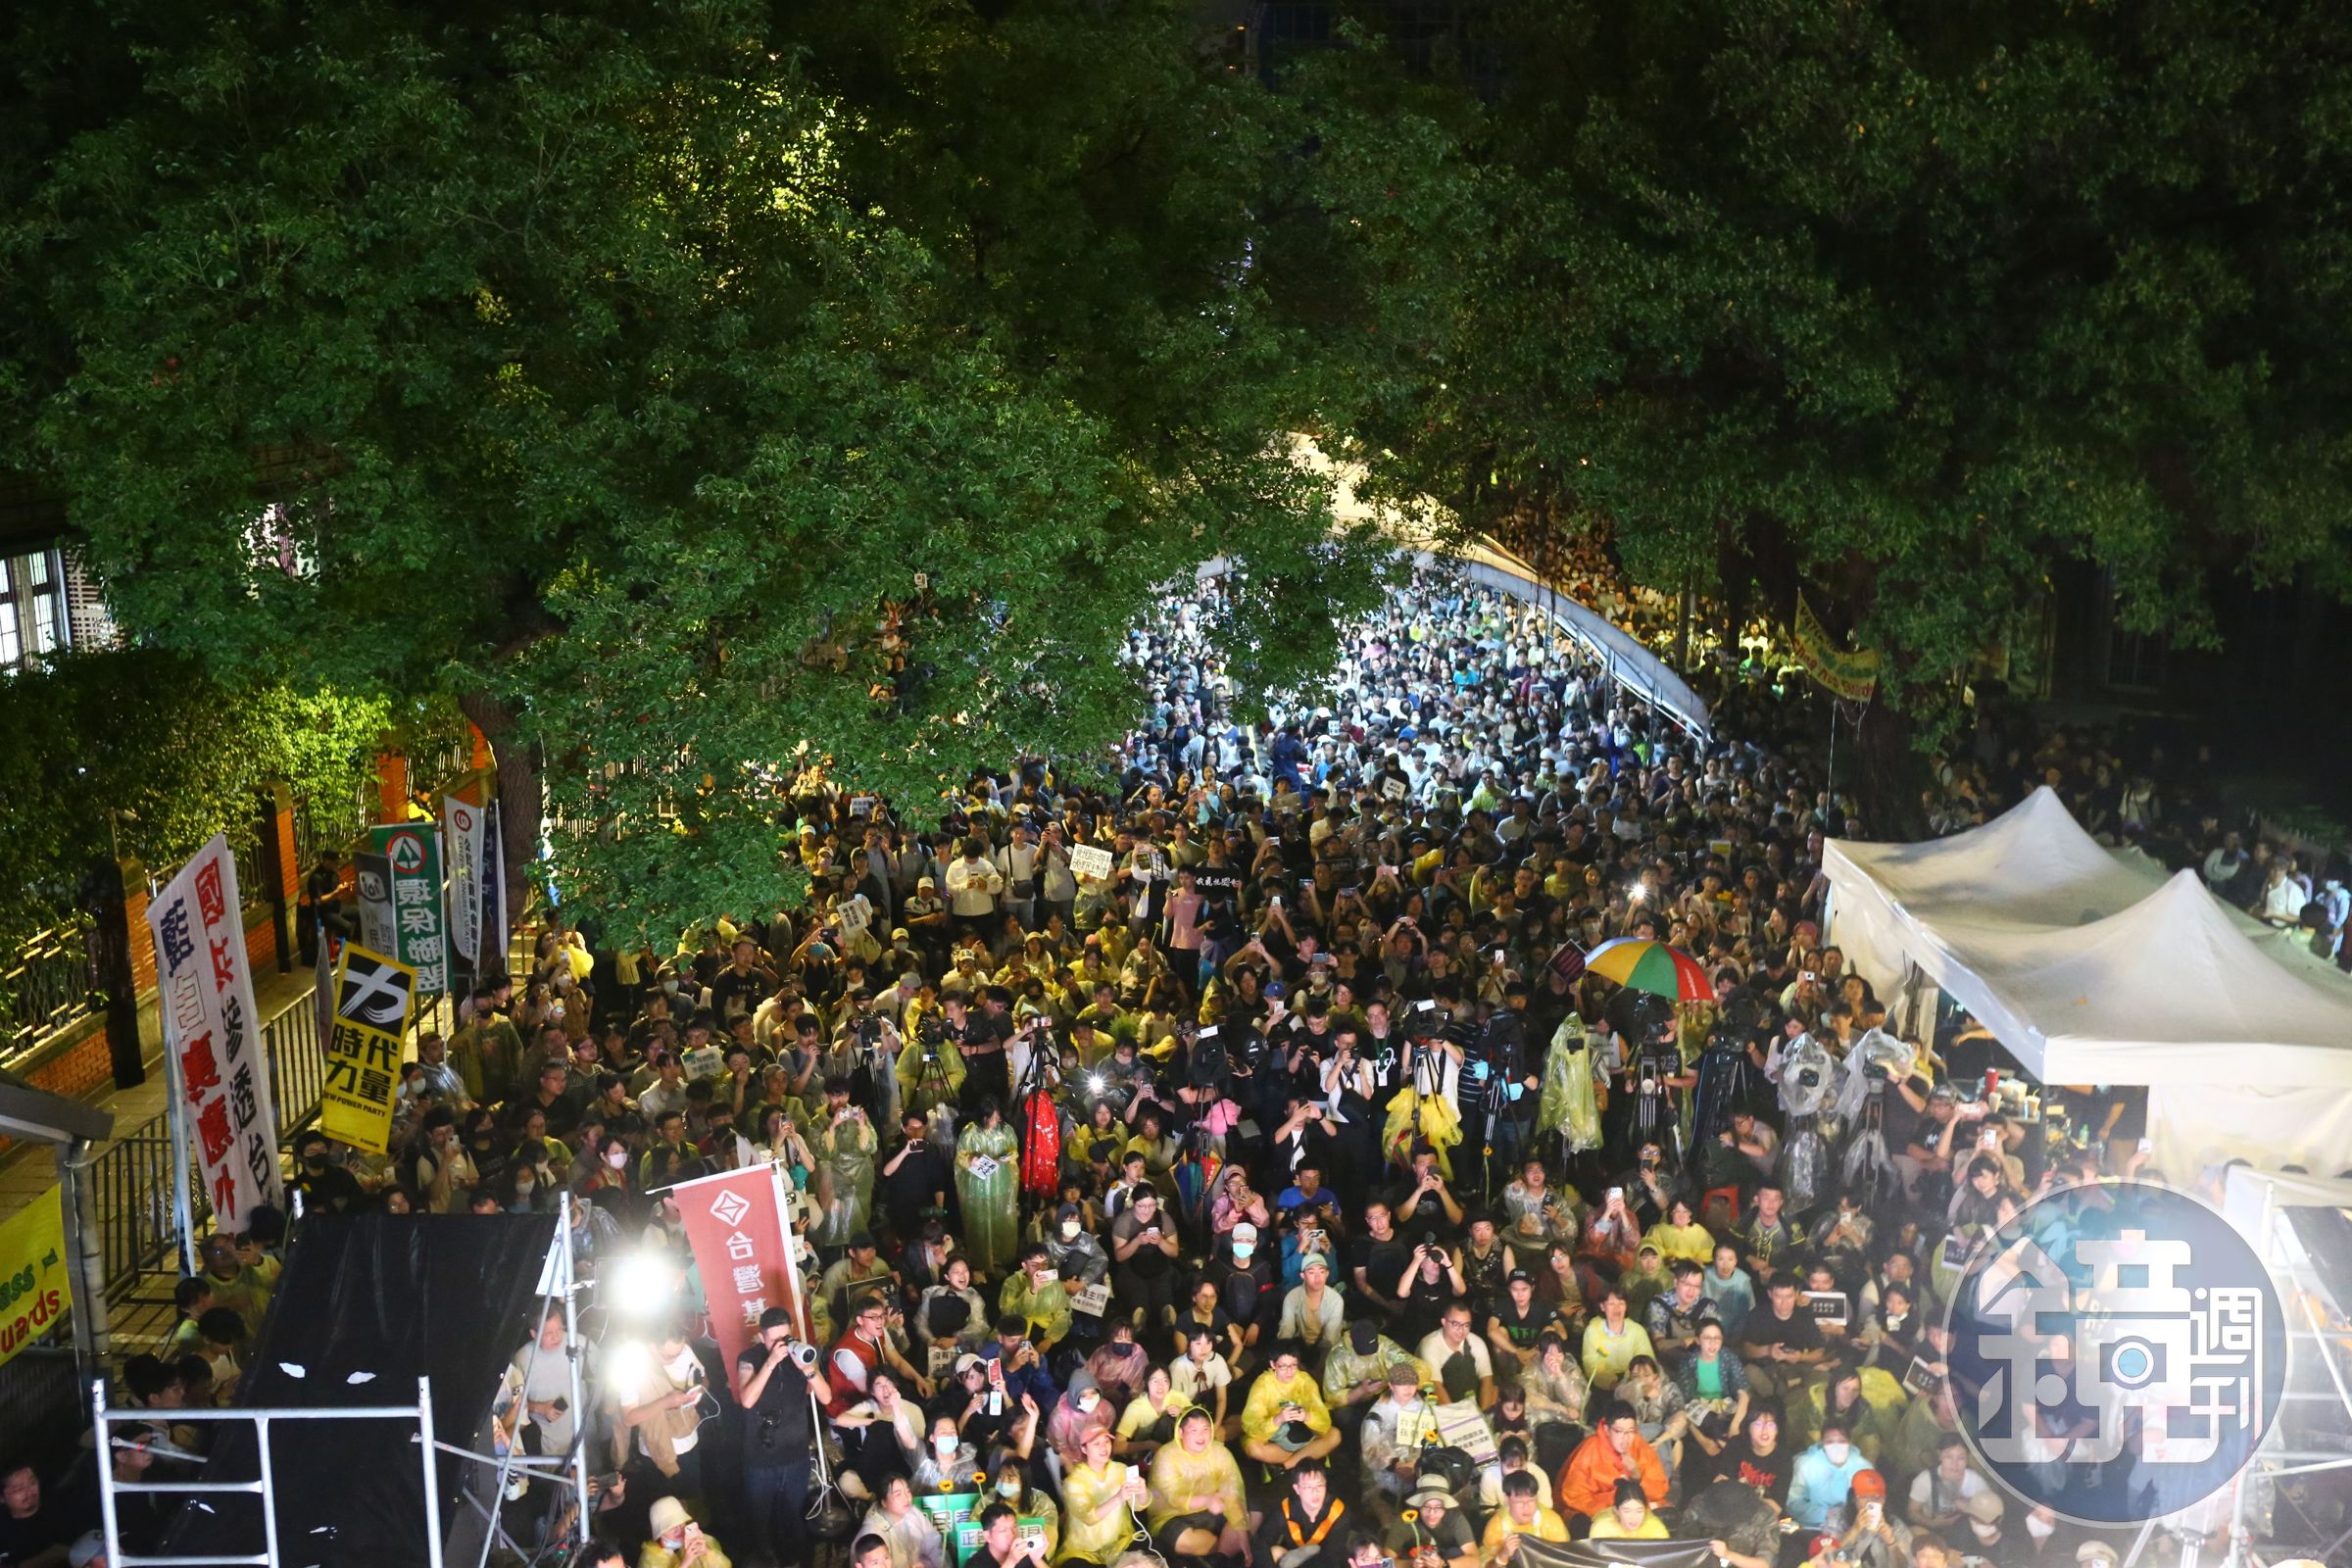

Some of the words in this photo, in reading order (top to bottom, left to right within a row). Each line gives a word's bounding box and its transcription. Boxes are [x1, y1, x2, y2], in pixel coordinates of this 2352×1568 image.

[195, 857, 273, 1206] 國共滲透台
[330, 1023, 398, 1072] 時代
[325, 1059, 391, 1105] 力量
[336, 1096, 363, 1110] POWER
[363, 1104, 386, 1118] PARTY
